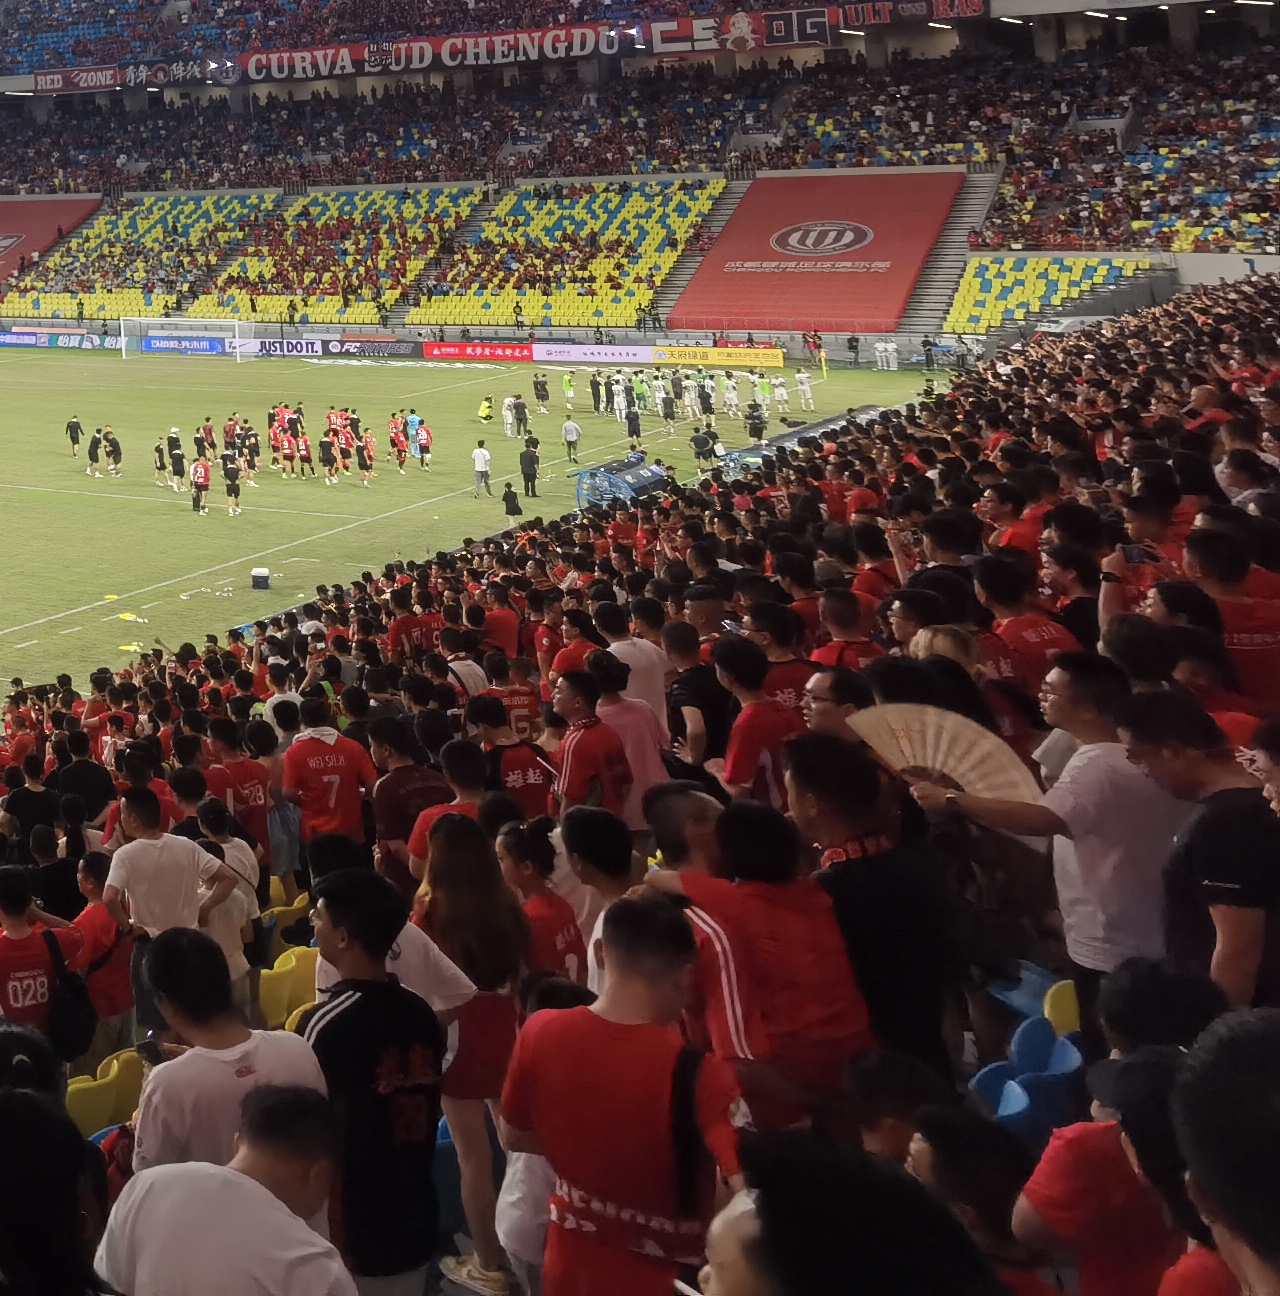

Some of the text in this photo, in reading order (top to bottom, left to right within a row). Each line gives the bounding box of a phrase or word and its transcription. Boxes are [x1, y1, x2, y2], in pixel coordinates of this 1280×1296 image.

[248, 48, 356, 80] CURVA
[441, 26, 619, 67] CHENGDU
[37, 69, 114, 90] RED ZONE
[258, 341, 283, 353] JUST
[287, 342, 304, 354] DO
[322, 774, 340, 809] 7
[8, 975, 49, 1008] 028
